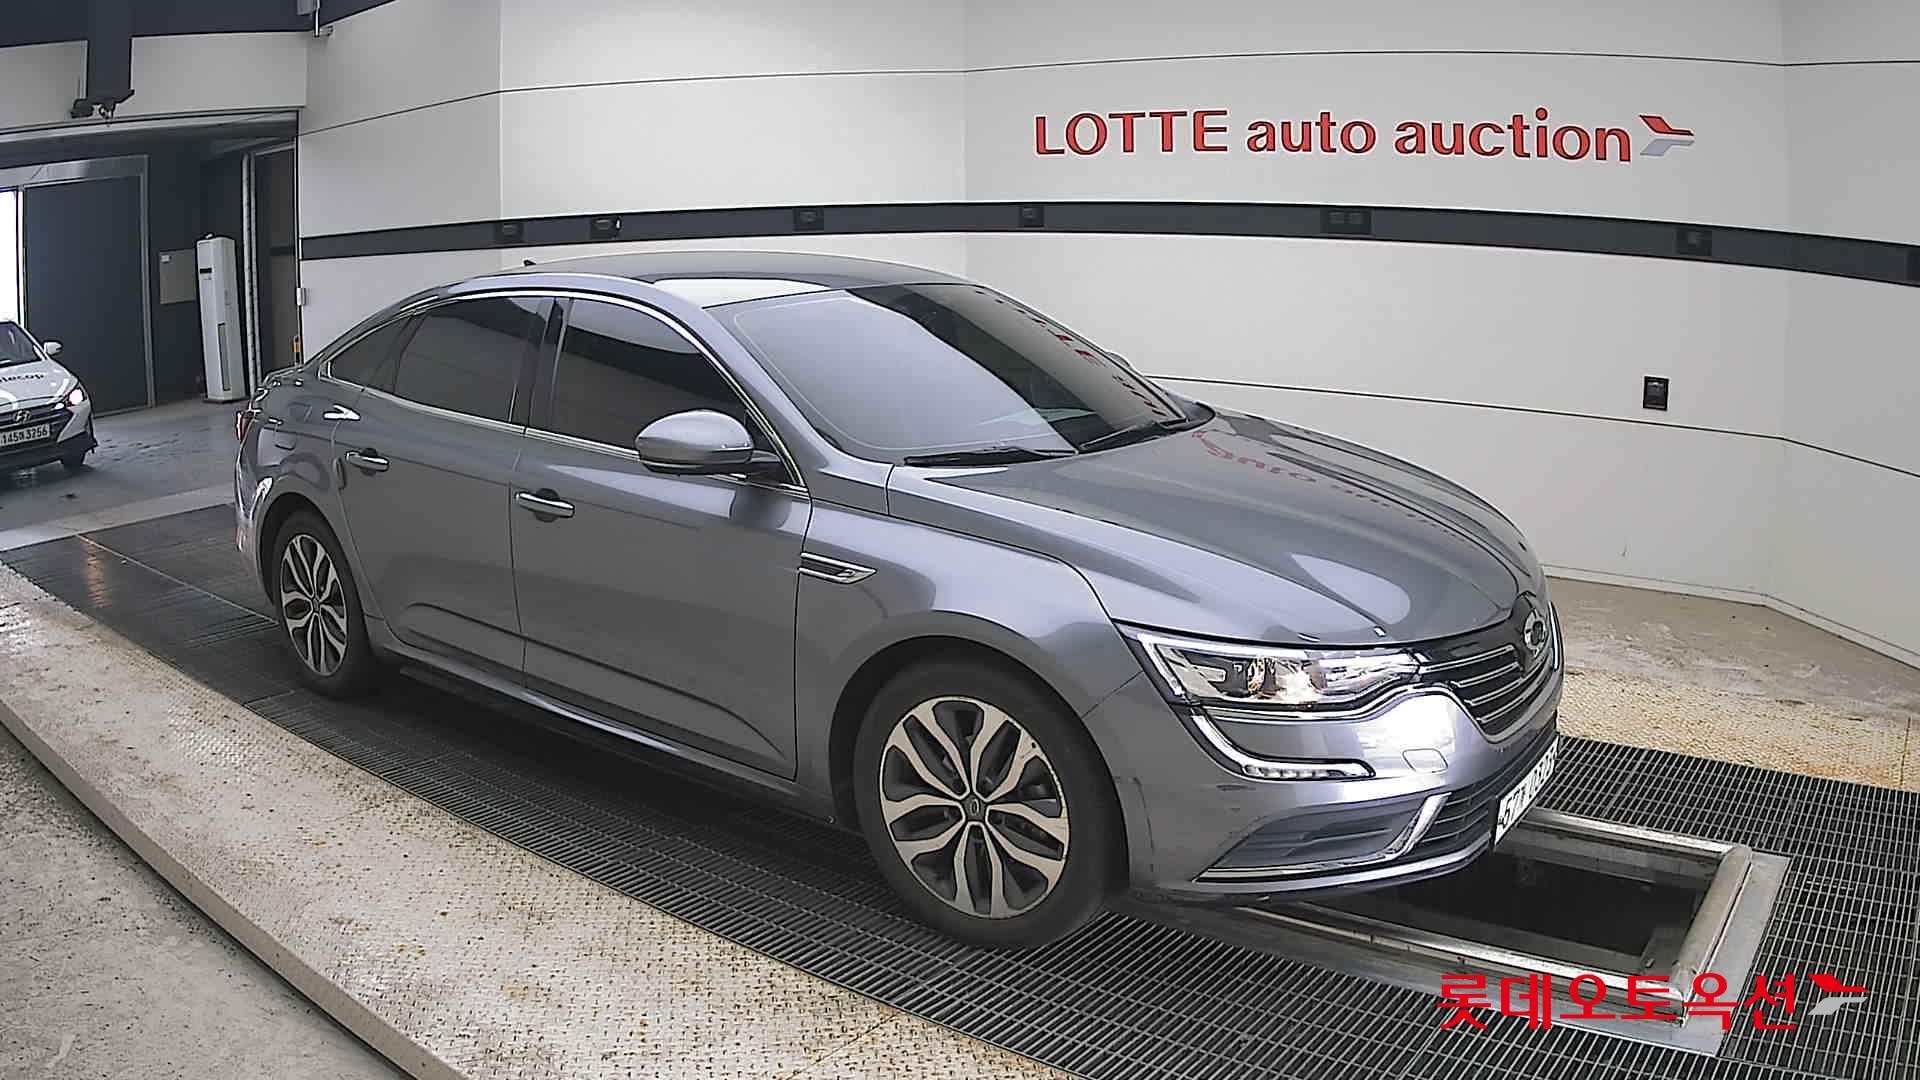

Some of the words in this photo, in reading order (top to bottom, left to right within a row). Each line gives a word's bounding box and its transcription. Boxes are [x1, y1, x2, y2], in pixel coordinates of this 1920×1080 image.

[1035, 109, 1229, 155] LOTTE
[1246, 111, 1377, 154] auto
[1394, 107, 1632, 163] auction
